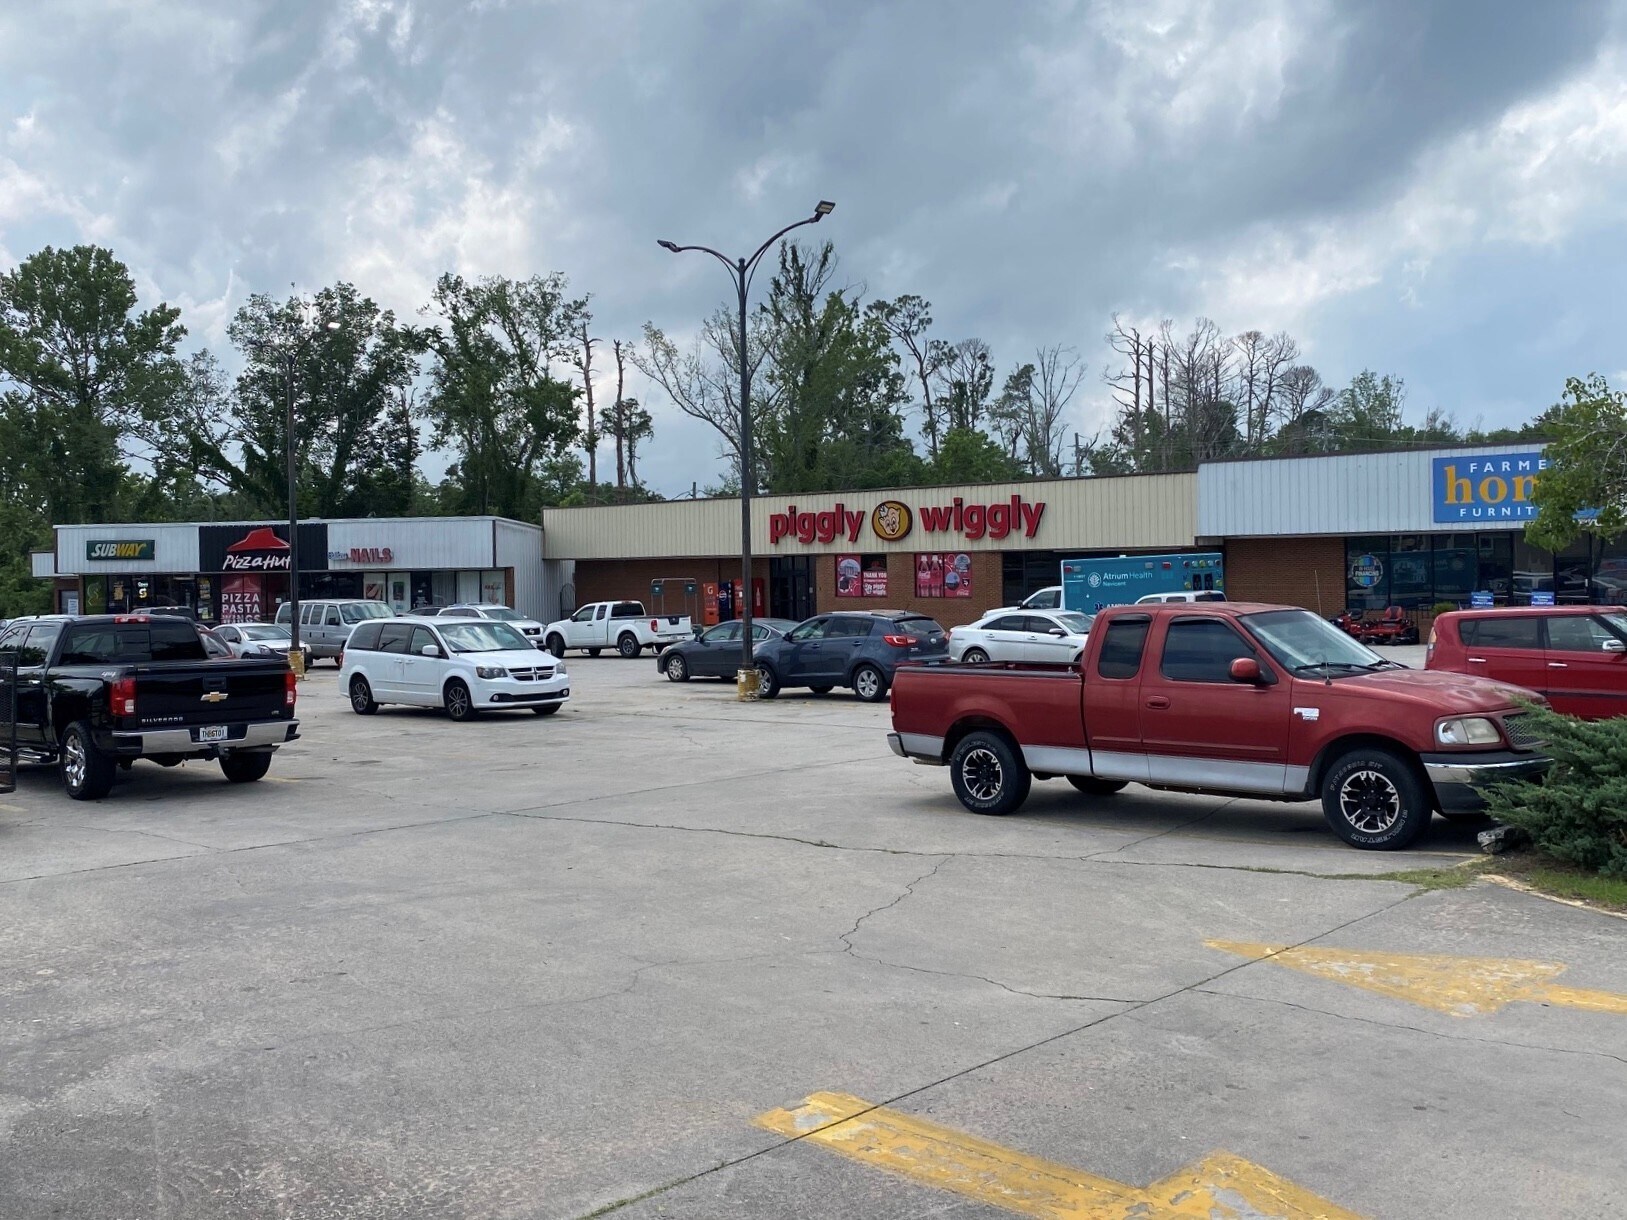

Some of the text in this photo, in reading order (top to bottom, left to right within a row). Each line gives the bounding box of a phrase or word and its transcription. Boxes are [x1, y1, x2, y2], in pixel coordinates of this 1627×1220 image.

[1469, 459, 1547, 473] FARME
[1444, 465, 1540, 504] ho
[1459, 506, 1542, 518] FURNIT
[770, 495, 1046, 544] piggly wiggly
[91, 543, 147, 557] SUBWAY
[350, 547, 393, 563] NAILS
[222, 554, 290, 570] Pizza Hut
[1102, 571, 1153, 580] Atrium Health
[222, 593, 260, 603] PIZZA
[222, 604, 260, 613] PASTA
